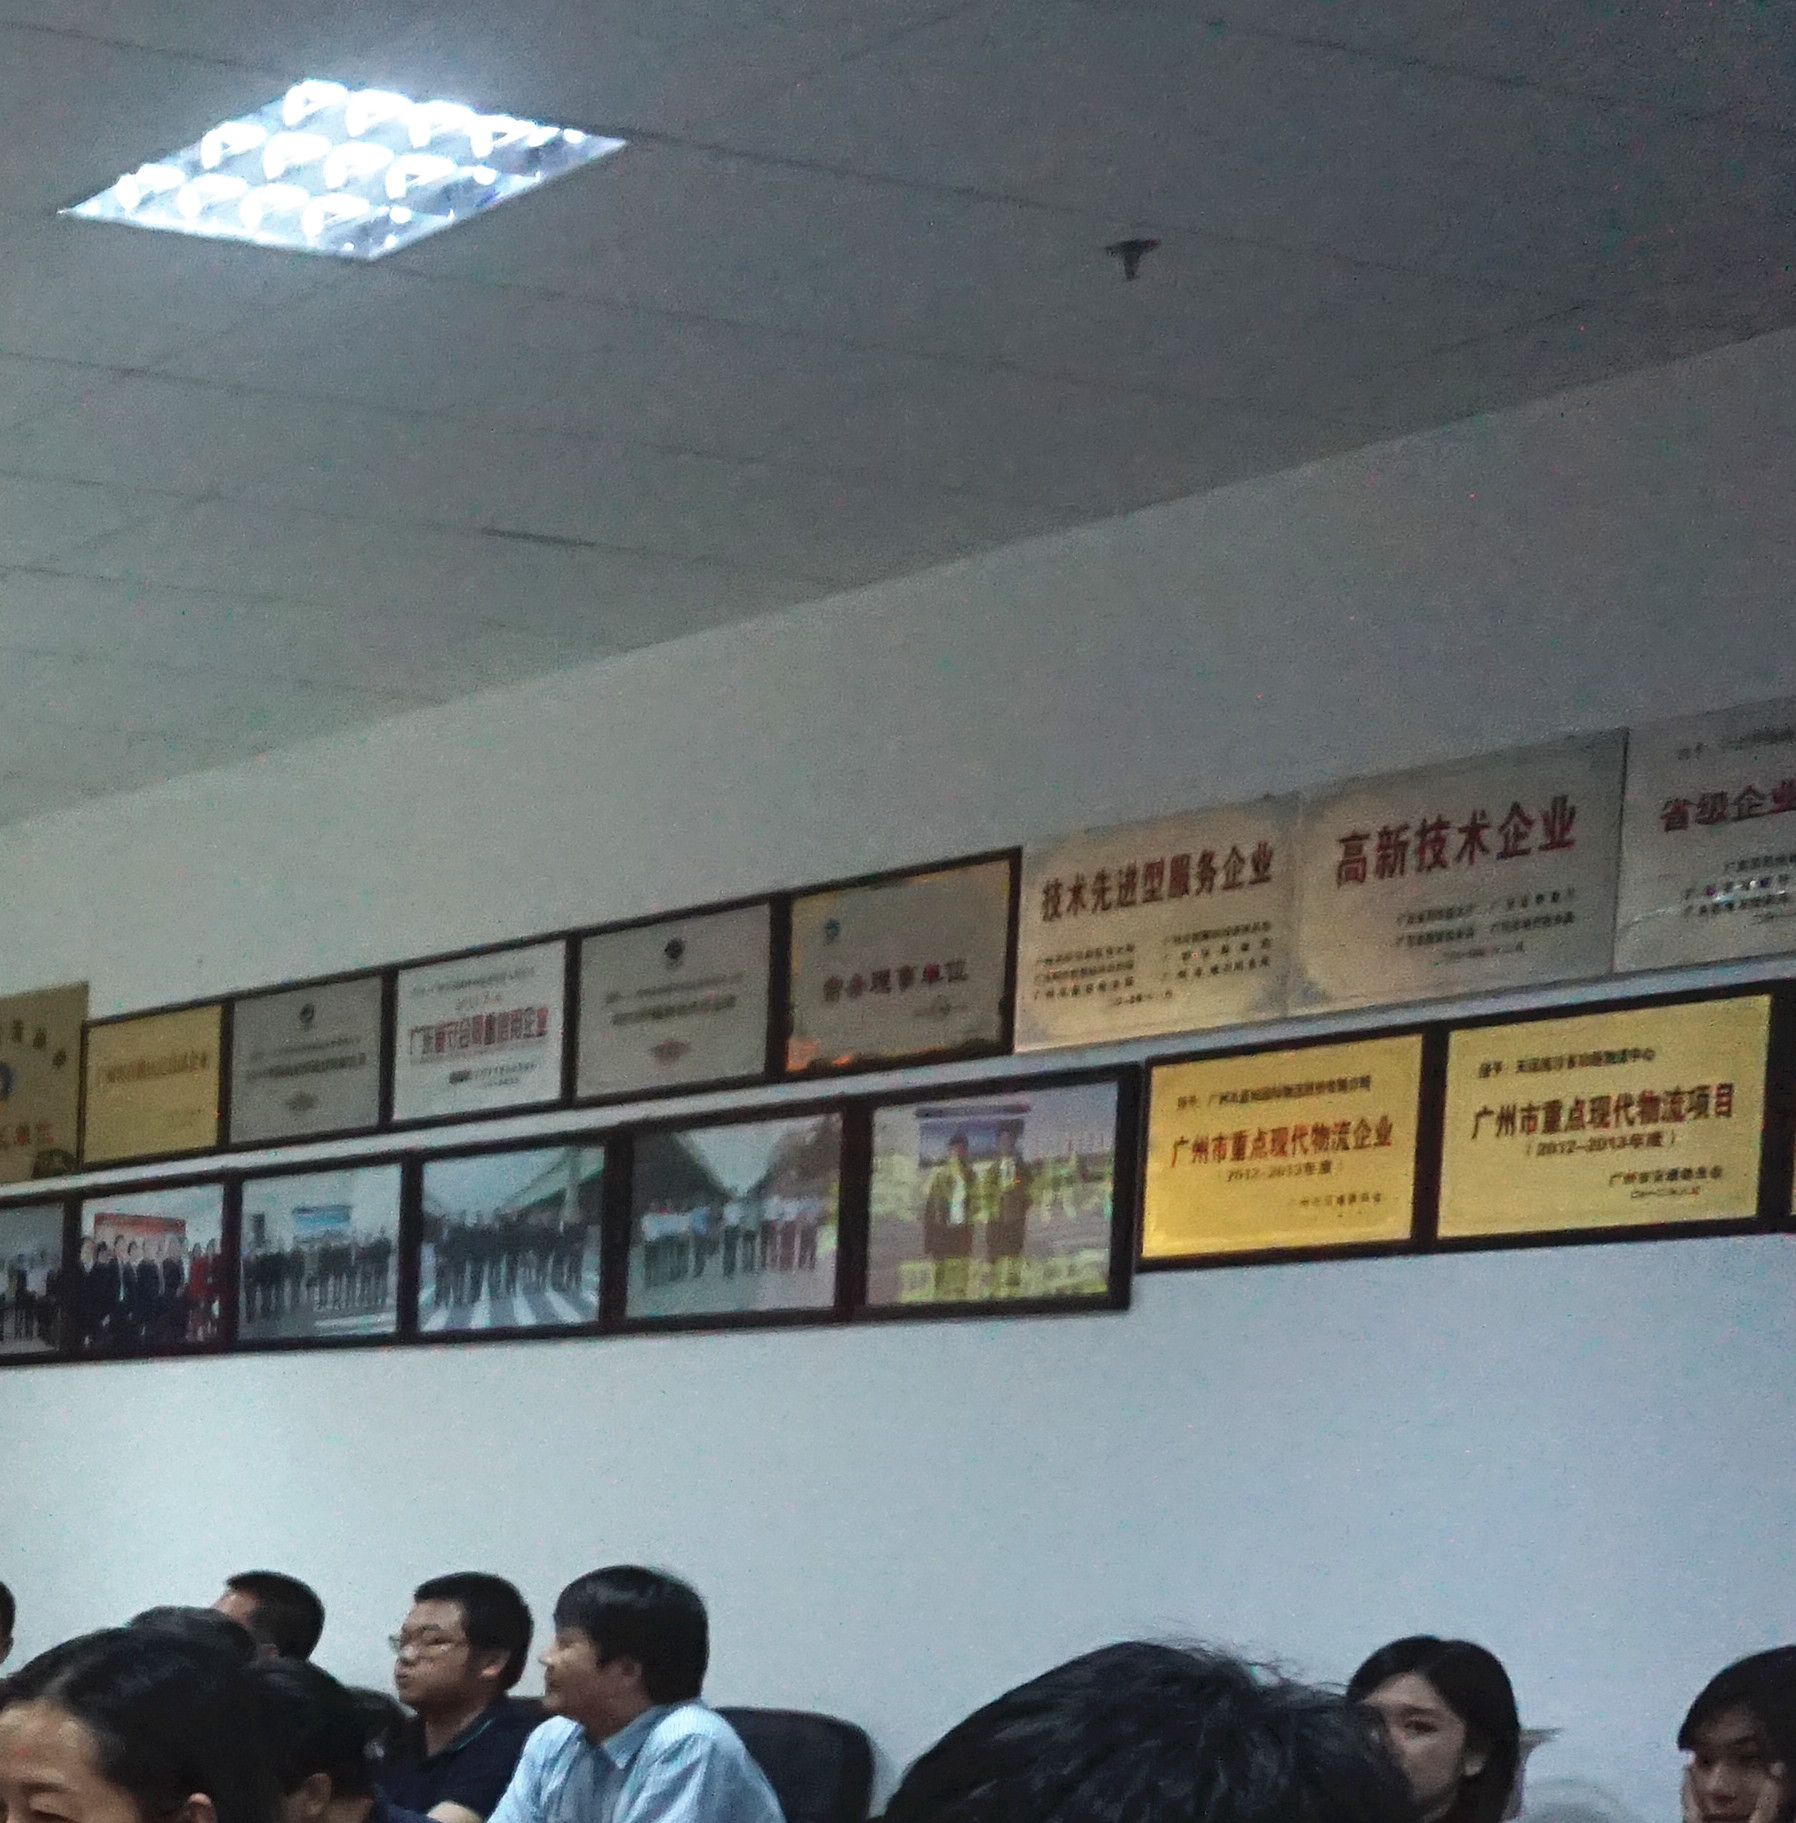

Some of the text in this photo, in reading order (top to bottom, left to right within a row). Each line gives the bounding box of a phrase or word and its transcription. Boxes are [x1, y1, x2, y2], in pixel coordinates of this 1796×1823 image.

[1336, 795, 1576, 889] 高新技术企业
[1042, 840, 1274, 922] 技术先进型服务企业
[1171, 1114, 1393, 1168] 广州市重点现代物流企业
[1471, 1083, 1734, 1139] 广州市重点现代物流项目
